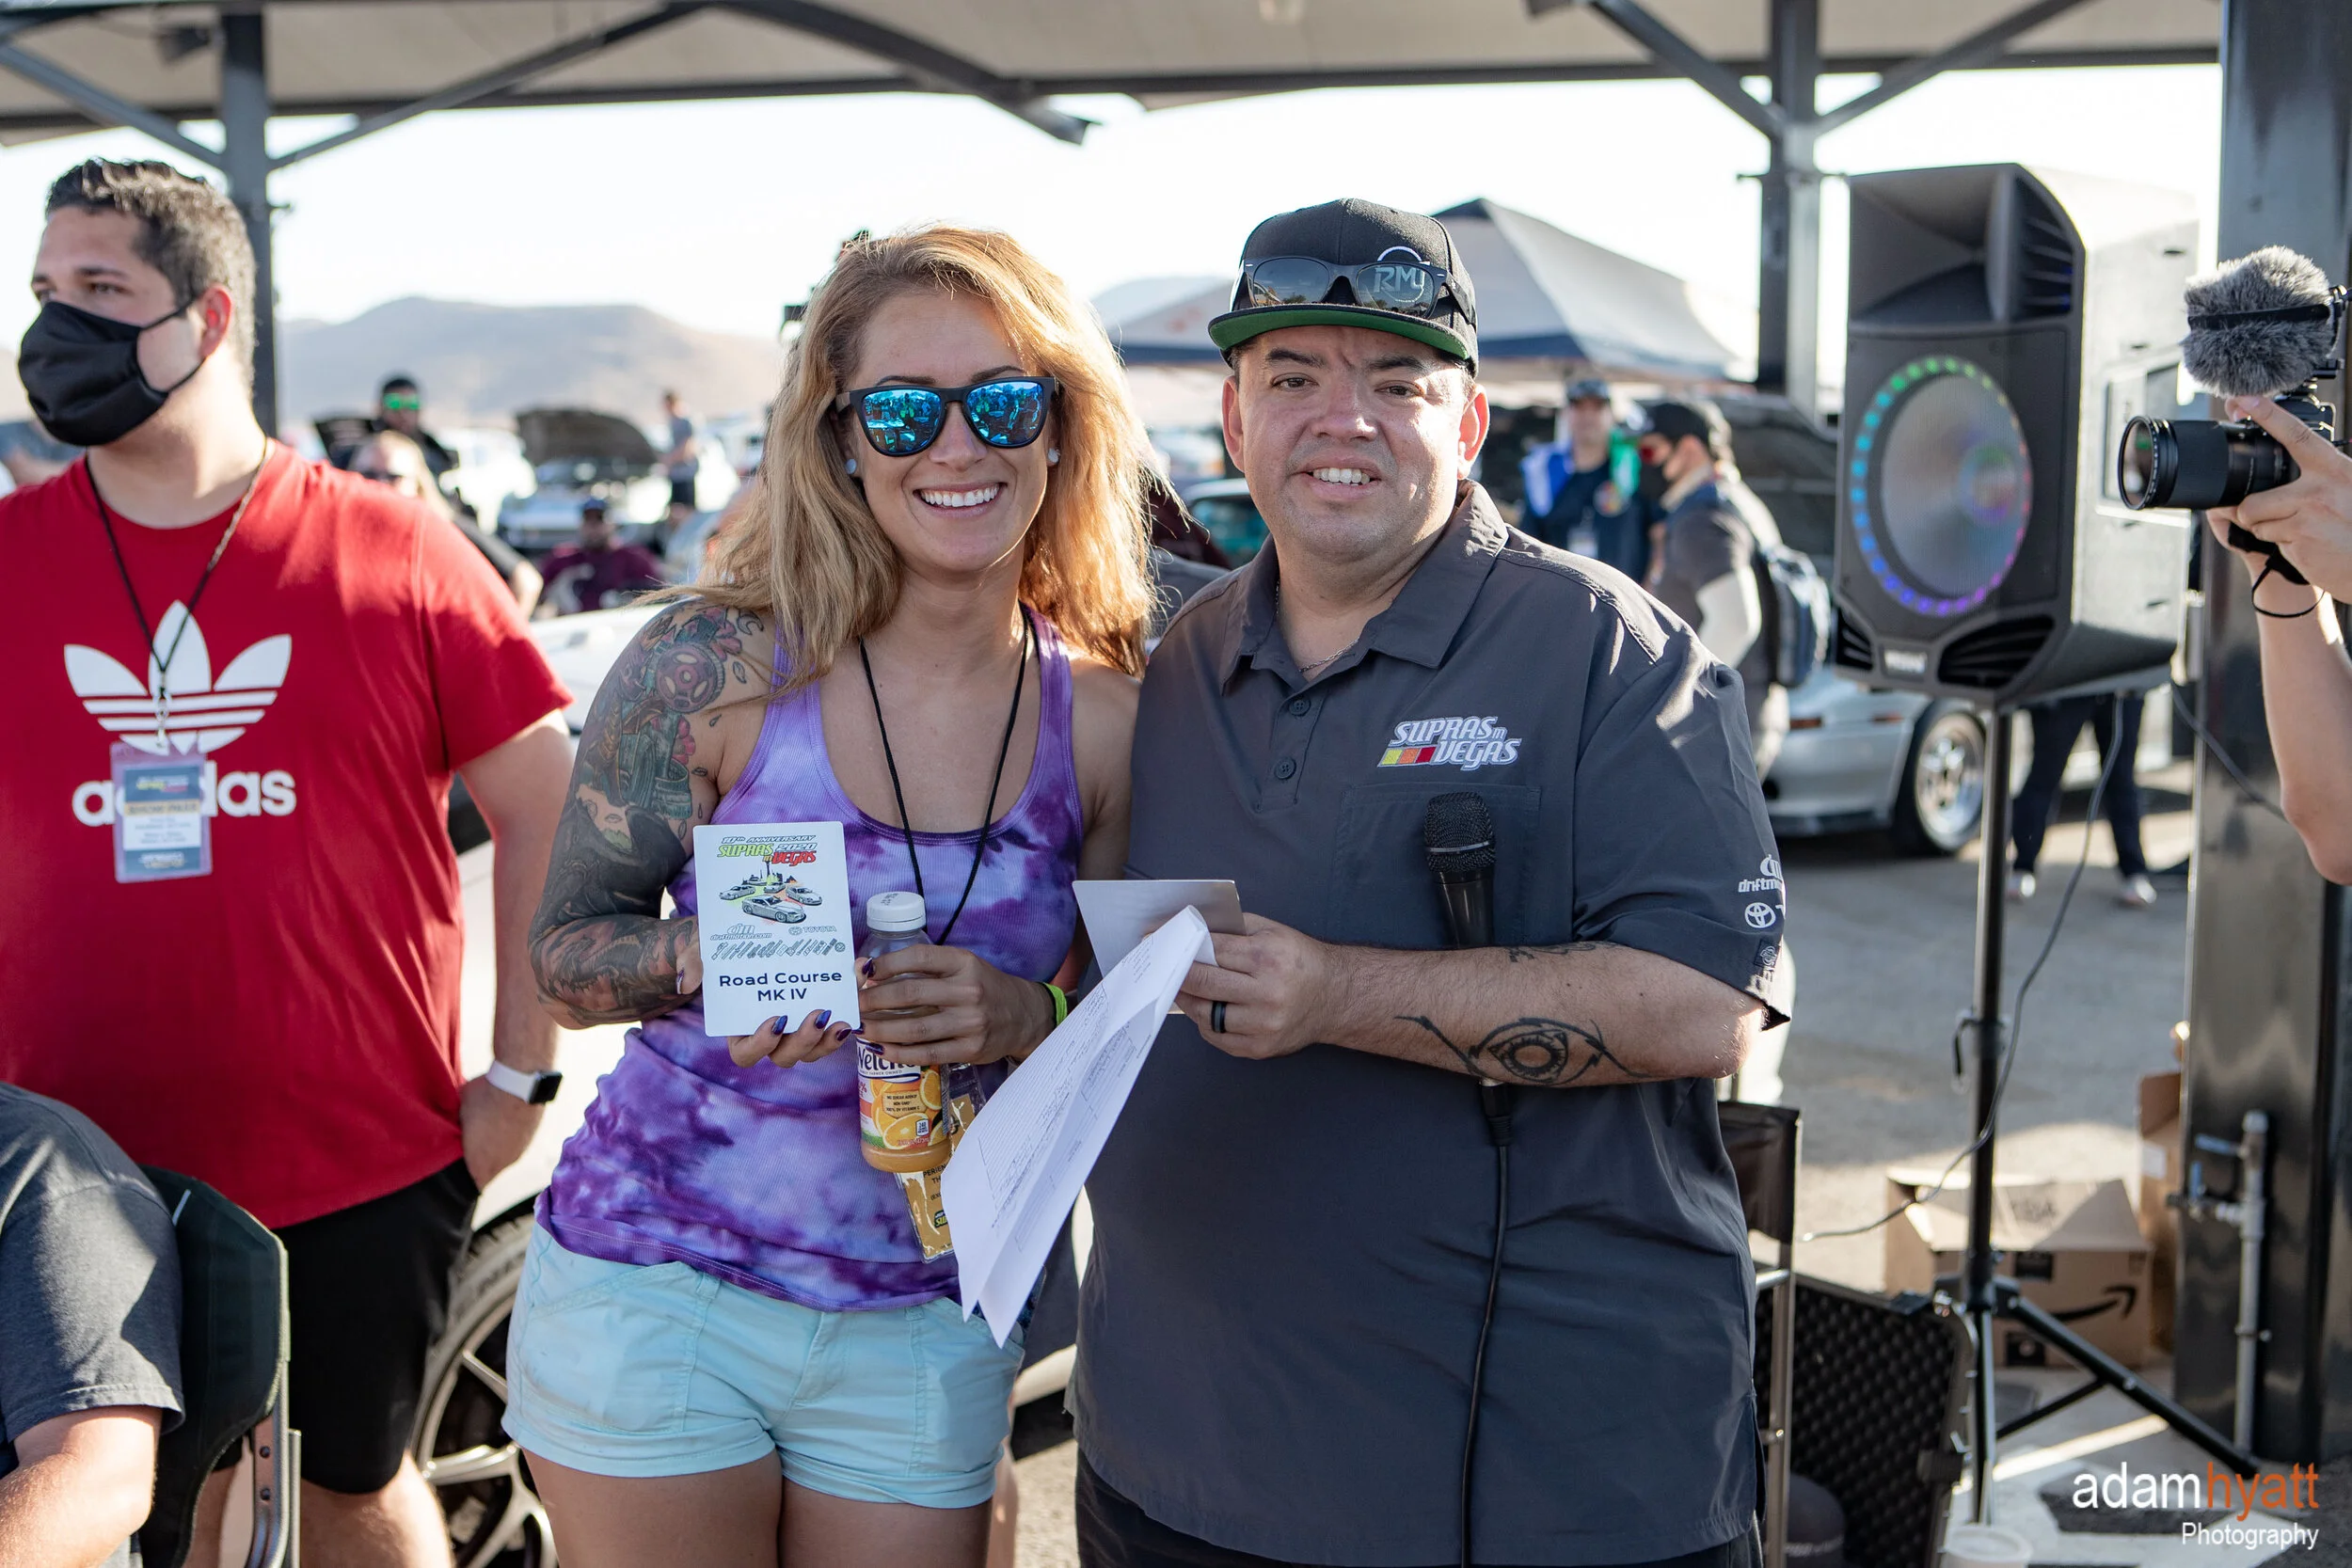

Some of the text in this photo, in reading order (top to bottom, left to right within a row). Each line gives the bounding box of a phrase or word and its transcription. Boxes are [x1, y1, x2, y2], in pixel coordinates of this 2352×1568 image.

[1389, 716, 1498, 748] SUPRAS
[1432, 738, 1522, 770] VEGAS
[72, 759, 297, 828] adas
[746, 835, 817, 844] ANNIVERSARY
[717, 843, 818, 858] SUPRAS 2020
[771, 850, 817, 866] VEGAS
[719, 972, 843, 987] Road Course
[757, 988, 807, 1002] MK IV
